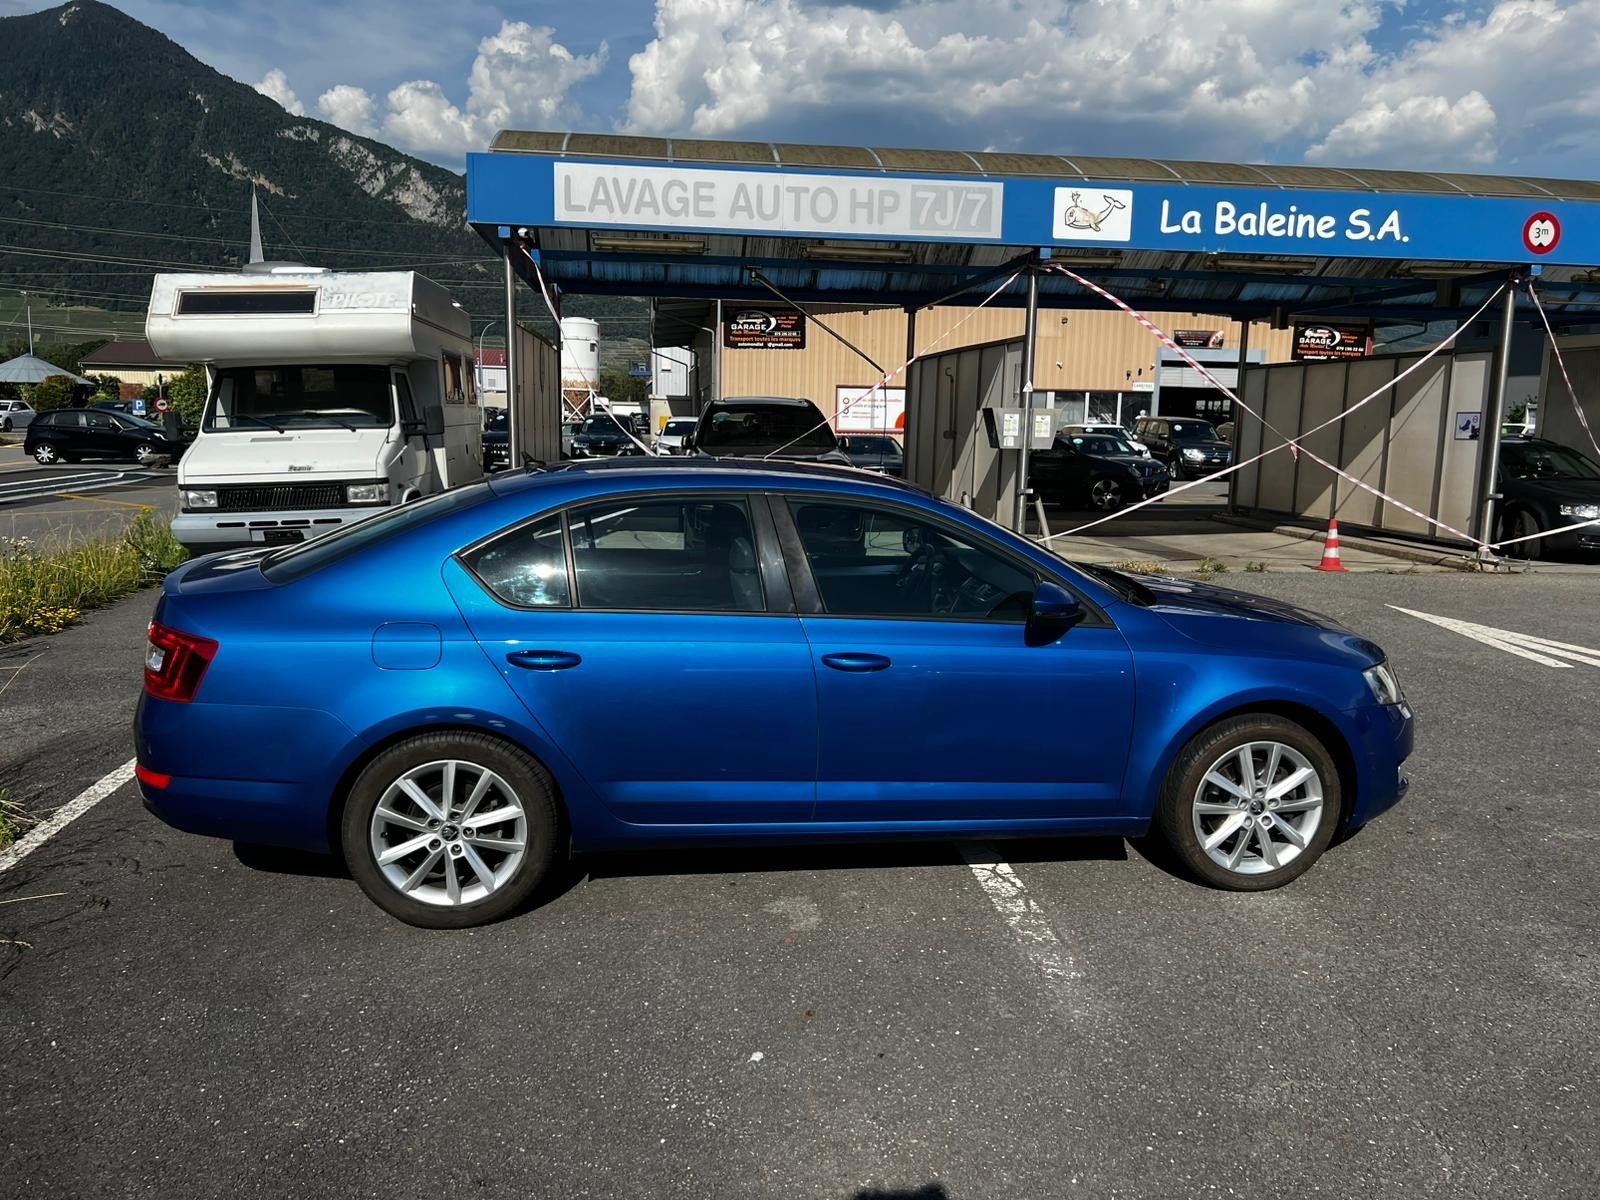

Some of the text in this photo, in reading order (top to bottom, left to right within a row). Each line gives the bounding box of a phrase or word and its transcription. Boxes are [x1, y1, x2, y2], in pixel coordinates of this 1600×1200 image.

[563, 174, 988, 230] LAVAGE AUTO HP 7J/7
[1160, 199, 1410, 243] La Baleine S.A.
[731, 323, 767, 331] GARAGE
[1299, 337, 1333, 345] GARAGE
[136, 400, 143, 410] P
